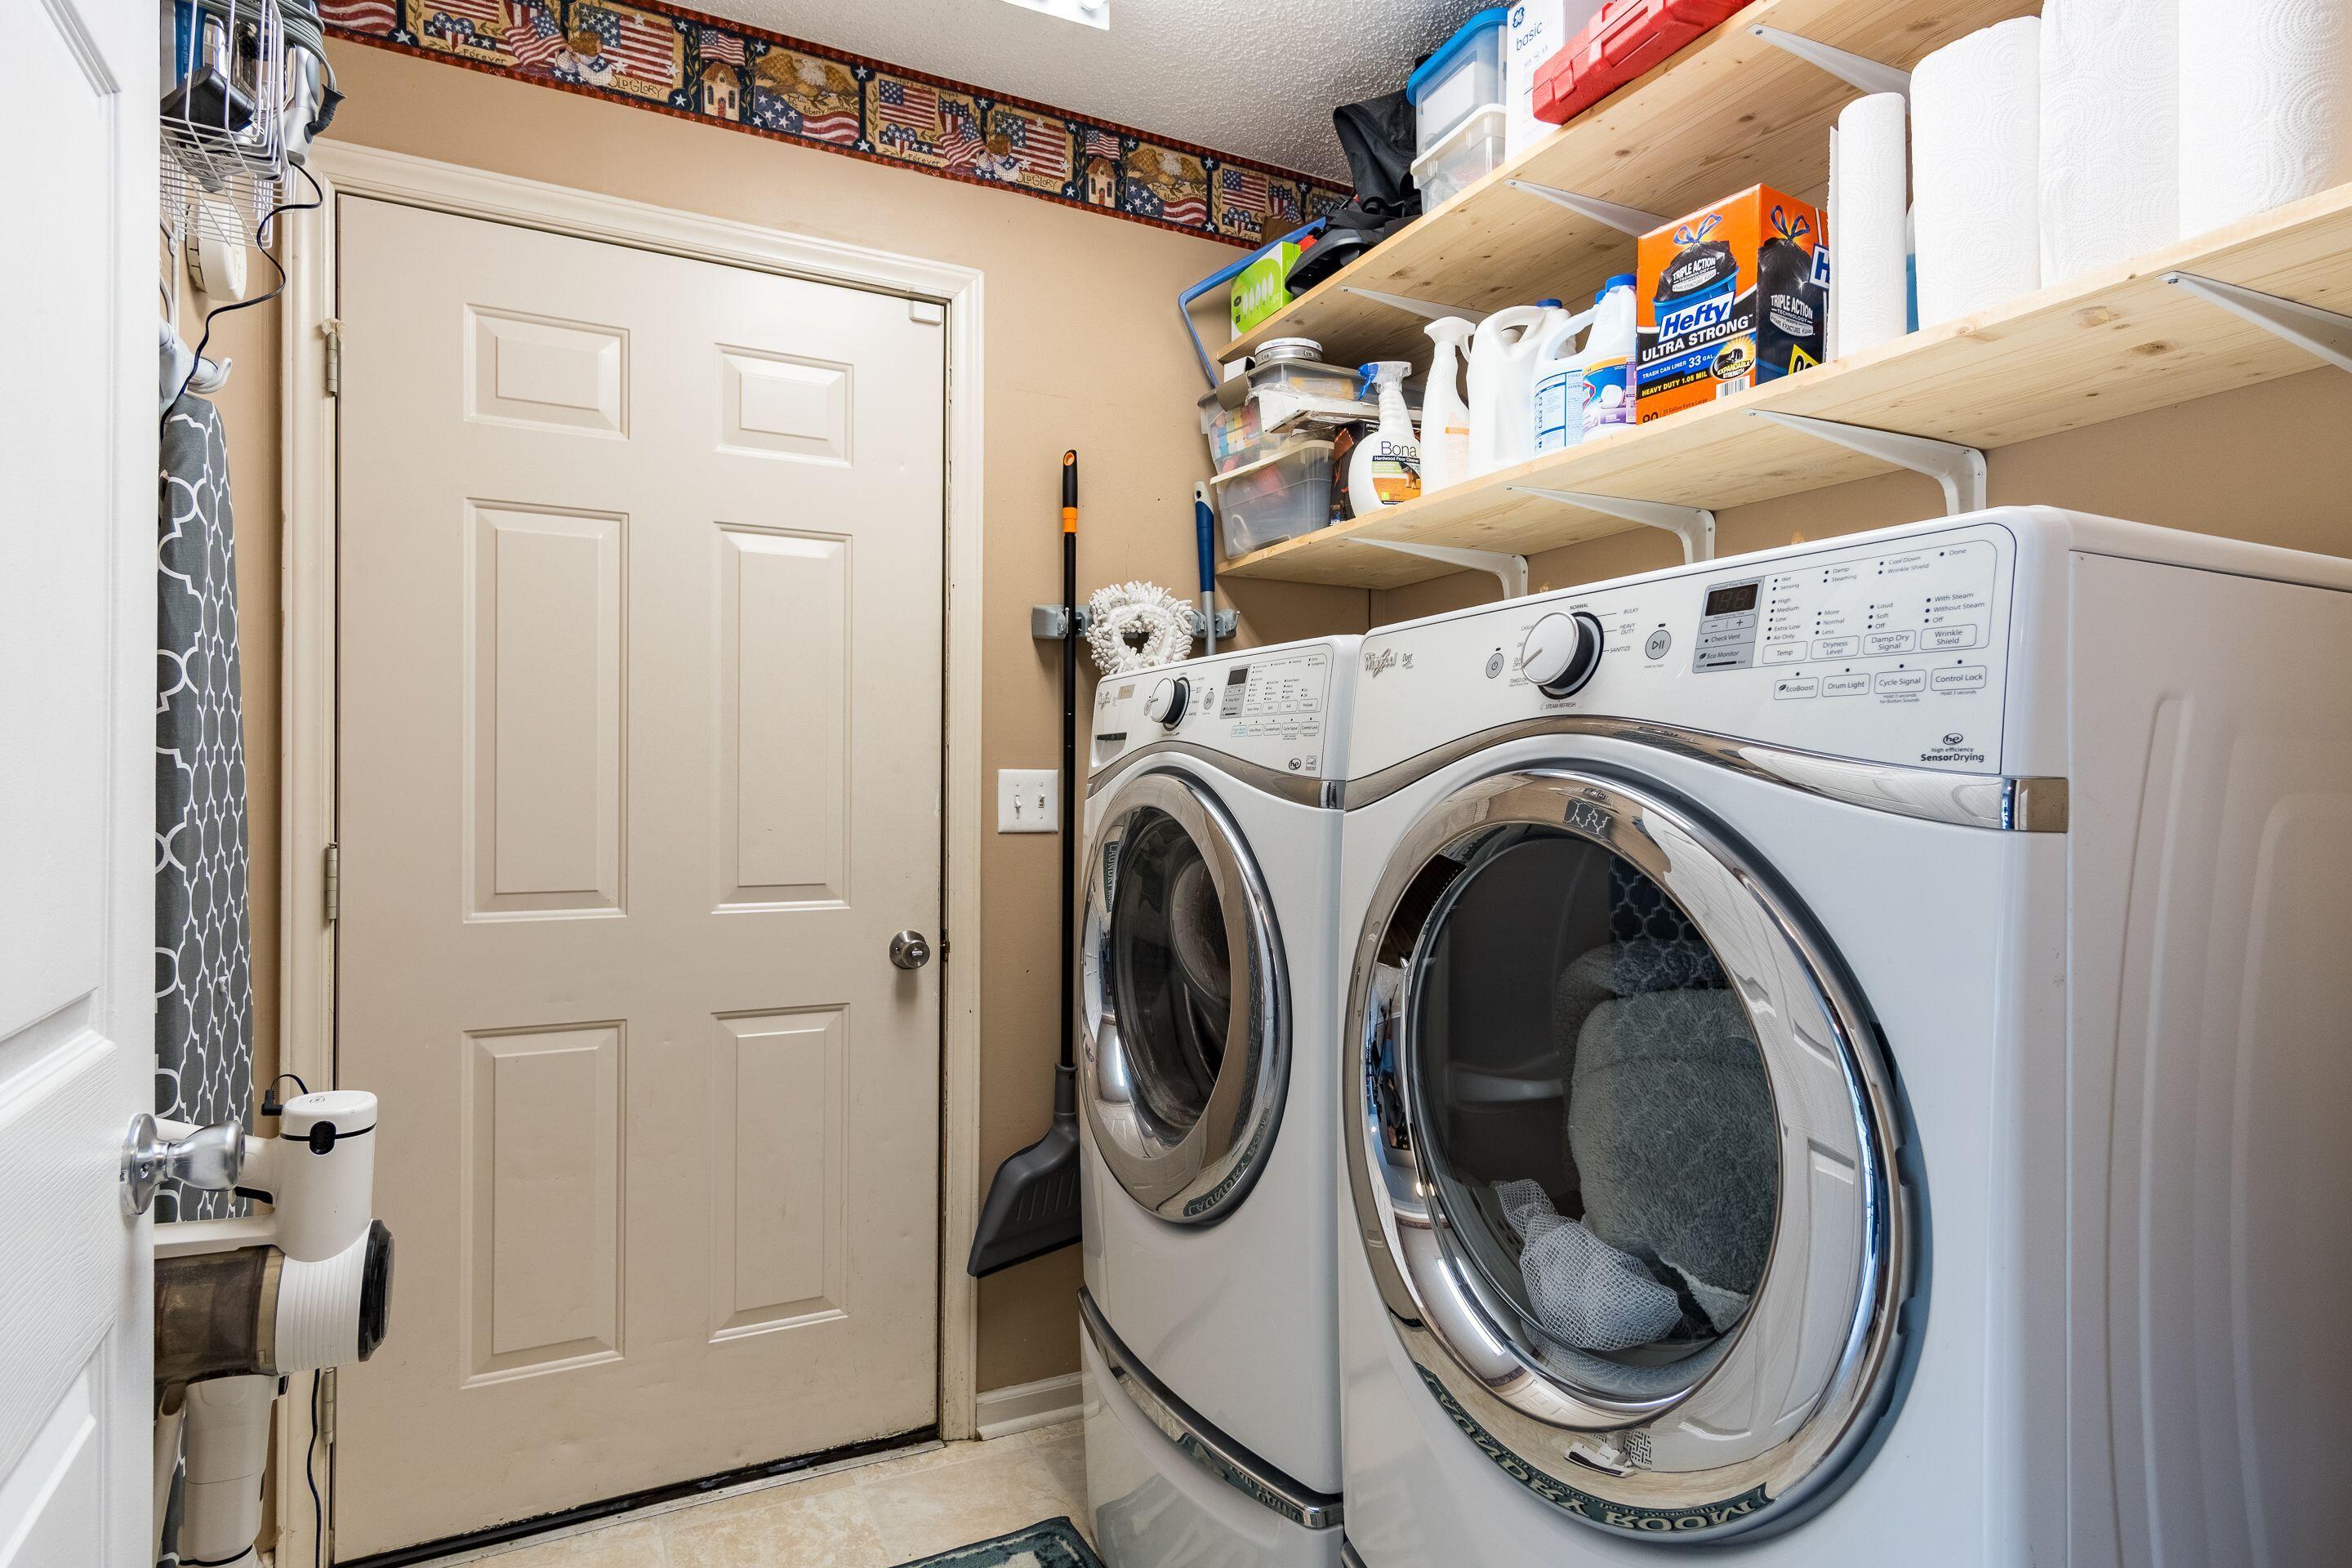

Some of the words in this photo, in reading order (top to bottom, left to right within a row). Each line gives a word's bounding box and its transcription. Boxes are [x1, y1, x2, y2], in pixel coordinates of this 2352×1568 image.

[1516, 22, 1543, 51] basic
[462, 47, 507, 65] Forever
[630, 79, 663, 99] GLORY
[1033, 175, 1058, 191] GLORY
[1673, 262, 1692, 281] TRIPLE
[1693, 257, 1716, 276] ACTION
[1678, 266, 1710, 283] TECHNOLOGY
[1771, 294, 1790, 311] TRIPLE
[1791, 296, 1813, 319] ACTION
[1664, 301, 1730, 337] Hefty
[1776, 309, 1808, 323] TECHNOLOGY
[1642, 337, 1685, 362] ULTRA
[1688, 318, 1748, 346] STRONG
[1642, 370, 1659, 379] TRASH
[1659, 365, 1671, 374] CAN
[1671, 361, 1686, 371] LINER
[1688, 354, 1701, 368] 33
[1717, 360, 1751, 376] EXPANDABLE
[1722, 368, 1745, 379] STRENGTH
[1642, 385, 1662, 397] HEAVY
[1663, 379, 1681, 390] DUTY
[1682, 374, 1695, 384] 1.05
[1695, 371, 1708, 380] MIL
[1381, 441, 1417, 457] Bona
[1949, 548, 1967, 556] Done
[1888, 557, 1902, 565] Cool
[1887, 565, 1909, 573] Wrinkle
[1911, 563, 1929, 571] Shield
[1934, 595, 1950, 603] With
[1951, 592, 1974, 600] Steam
[1623, 607, 1639, 615] BULKY
[1776, 605, 1800, 613] Medium
[1933, 604, 1961, 612] Without
[1962, 601, 1985, 609] Steam
[1935, 629, 1963, 637] Wrinkle
[1823, 640, 1849, 648] Dryness
[1936, 637, 1960, 645] Shield
[1878, 643, 1901, 651] Signal
[1717, 650, 1740, 658] Monitor
[1878, 679, 1898, 687] Cycle
[1899, 677, 1921, 686] Signal
[1935, 675, 1963, 683] Control
[1786, 684, 1815, 693] EcoBoost
[1847, 681, 1865, 689] Light
[1920, 753, 1984, 763] SensorDrying
